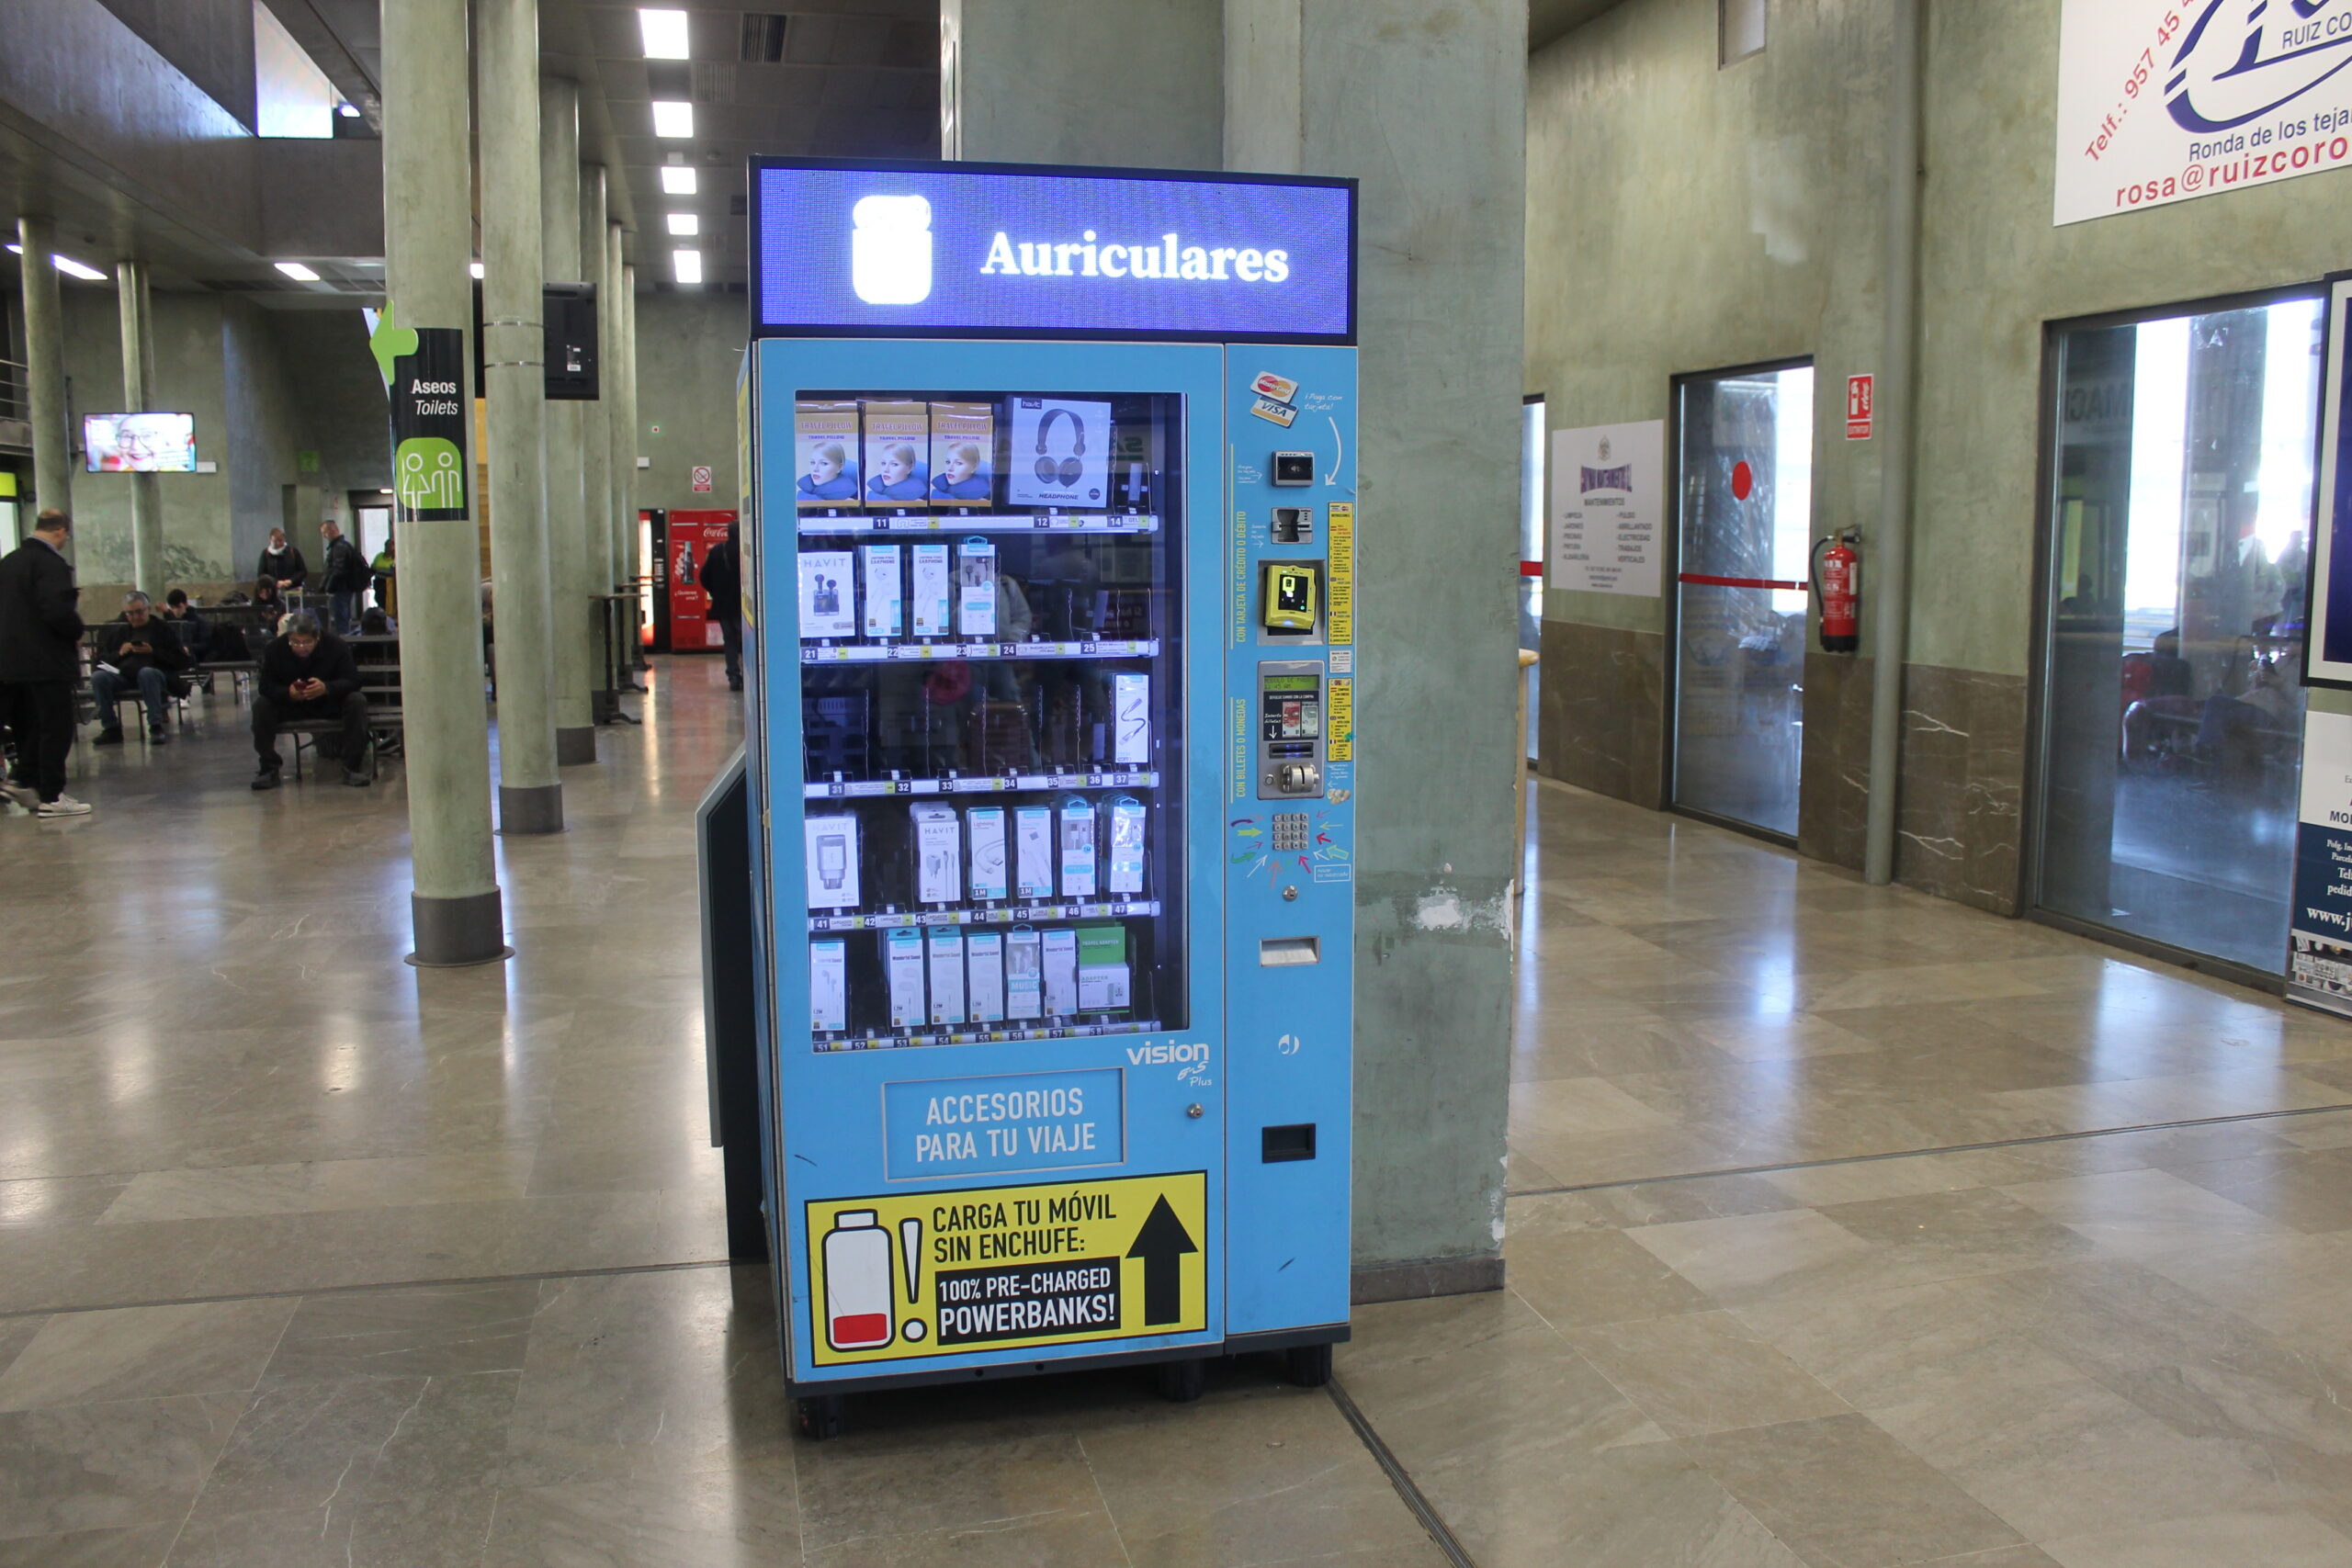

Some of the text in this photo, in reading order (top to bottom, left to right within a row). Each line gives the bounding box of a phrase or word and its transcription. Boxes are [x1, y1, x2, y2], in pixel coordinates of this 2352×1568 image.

[2282, 20, 2322, 50] RUIZ
[2084, 9, 2180, 163] Telf.: 957 45
[2188, 107, 2352, 162] Ronda de los teja
[979, 230, 1289, 282] Auriculares
[412, 378, 457, 394] Aseos
[414, 399, 458, 415] Toilets
[1261, 402, 1287, 418] VISA
[876, 518, 887, 527] 11
[1036, 518, 1048, 526] 12
[1110, 517, 1121, 525] 14
[1235, 511, 1246, 538] DÉBITO
[803, 558, 846, 568] HAVIT
[1235, 547, 1246, 580] CRÉDITO
[1237, 582, 1246, 592] DE
[1237, 593, 1246, 625] TARJETA
[1237, 626, 1246, 643] CON
[957, 647, 967, 655] 23
[1003, 646, 1014, 655] 24
[1084, 643, 1095, 652] 25
[805, 650, 816, 659] 21
[1236, 698, 1246, 736] MONEDAS
[1236, 745, 1246, 780] BILLETES
[1005, 779, 1015, 788] 34
[1048, 777, 1058, 786] 35
[1090, 775, 1101, 784] 36
[1116, 774, 1126, 784] 37
[832, 784, 842, 794] 31
[898, 783, 909, 792] 32
[943, 781, 953, 790] 33
[1236, 782, 1246, 797] CON
[2337, 867, 2352, 880] Tel
[1069, 906, 1079, 915] 46
[1115, 904, 1125, 913] 47
[974, 912, 985, 920] 44
[1016, 909, 1027, 919] 45
[817, 919, 827, 929] 41
[865, 918, 875, 926] 42
[916, 915, 926, 924] 43
[2306, 908, 2352, 931] www.j
[1011, 981, 1037, 990] MUSIC
[1012, 1032, 1023, 1040] 56
[1053, 1029, 1063, 1038] 57
[1090, 1027, 1101, 1035] 58
[897, 1039, 908, 1047] 53
[939, 1037, 949, 1045] 54
[979, 1034, 989, 1043] 55
[818, 1043, 828, 1052] 51
[855, 1042, 865, 1050] 52
[1126, 1040, 1209, 1066] vision
[1189, 1077, 1213, 1088] Plus
[926, 1088, 1083, 1126] ACCESORIOS
[916, 1122, 1096, 1163] PARA TU VIAJE
[933, 1190, 1117, 1233] CARGA TU MÓVIL
[933, 1227, 1086, 1263] SIN ENCHUFE:
[939, 1267, 1112, 1303] 100% PRE-CHARGED
[940, 1293, 1115, 1337] POWERBANKS!
